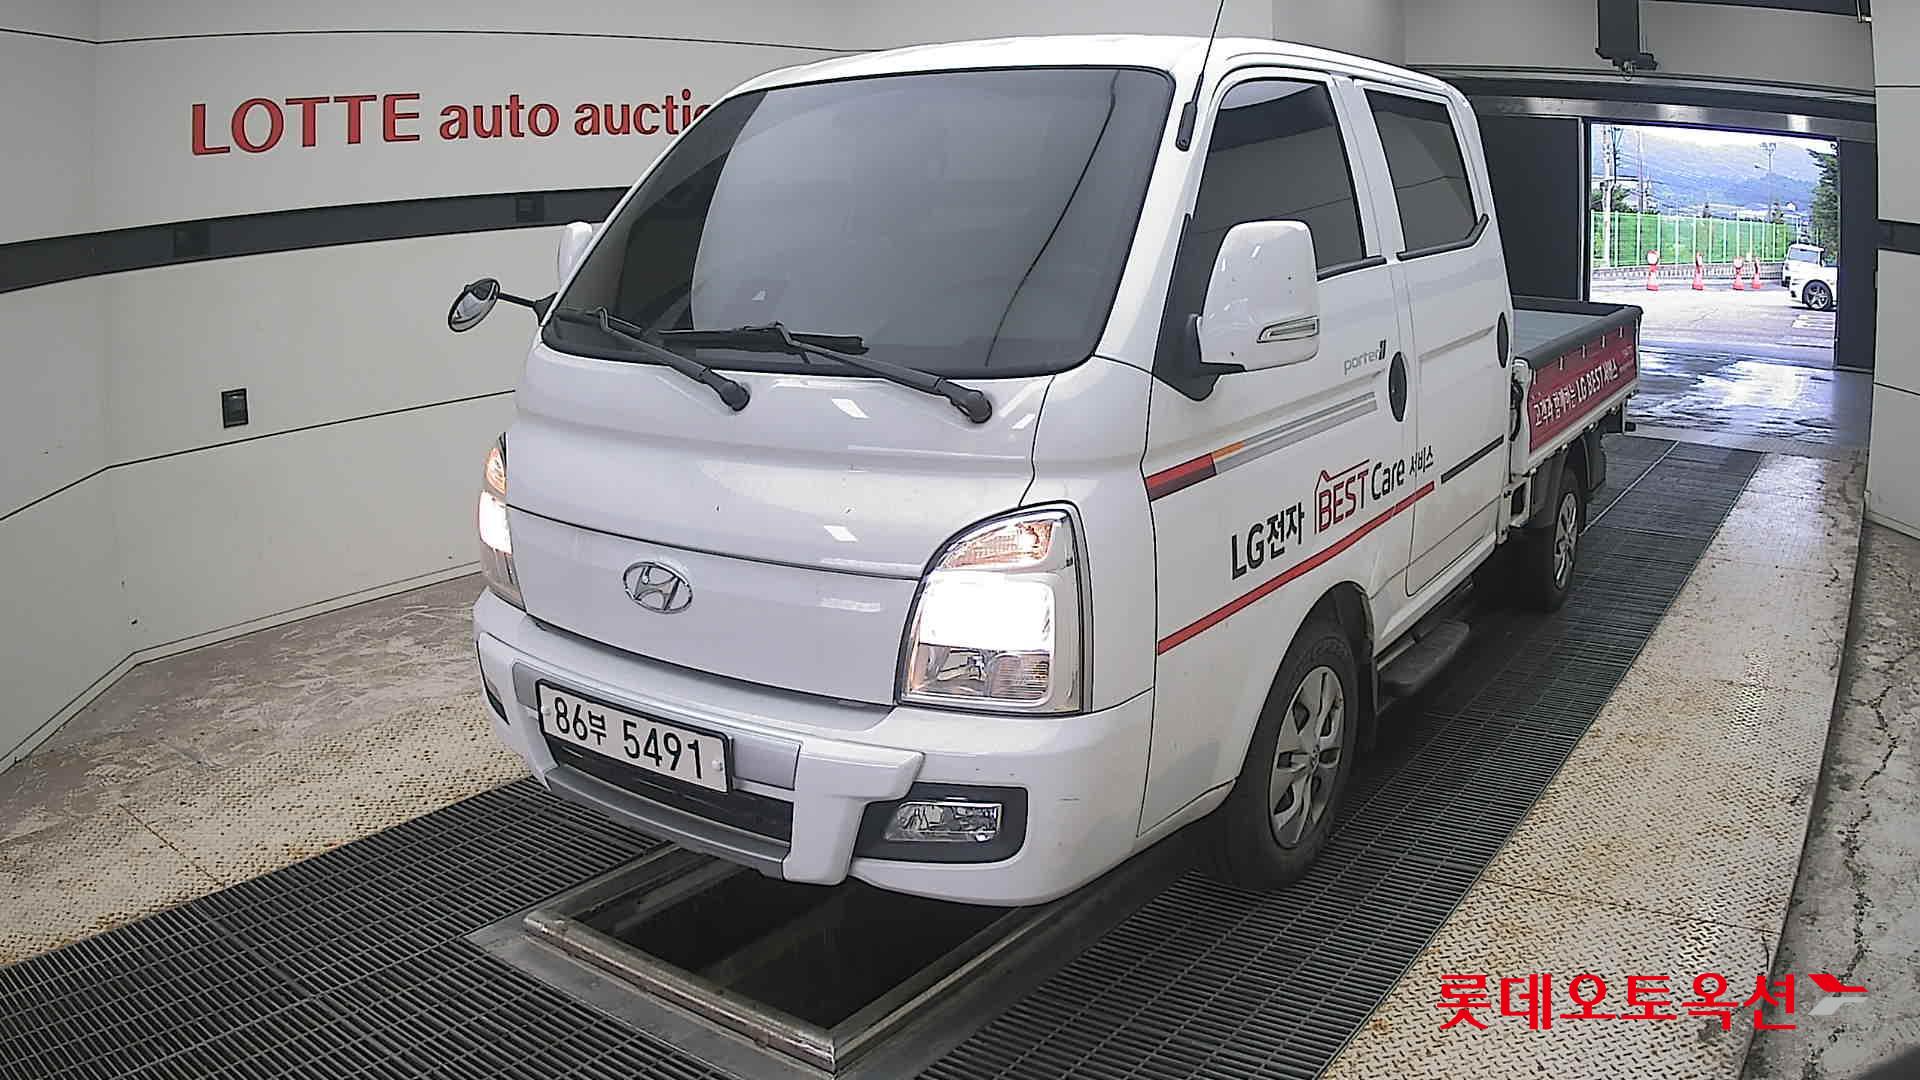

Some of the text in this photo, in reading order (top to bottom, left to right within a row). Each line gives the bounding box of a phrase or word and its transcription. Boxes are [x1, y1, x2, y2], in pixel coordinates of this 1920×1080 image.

[191, 88, 712, 156] LOTTE auto aucti
[1576, 376, 1588, 403] LG
[1587, 365, 1604, 397] BEST
[1231, 444, 1434, 580] LG전자 BEST Care 서비스
[554, 696, 703, 780] 86부 5491
